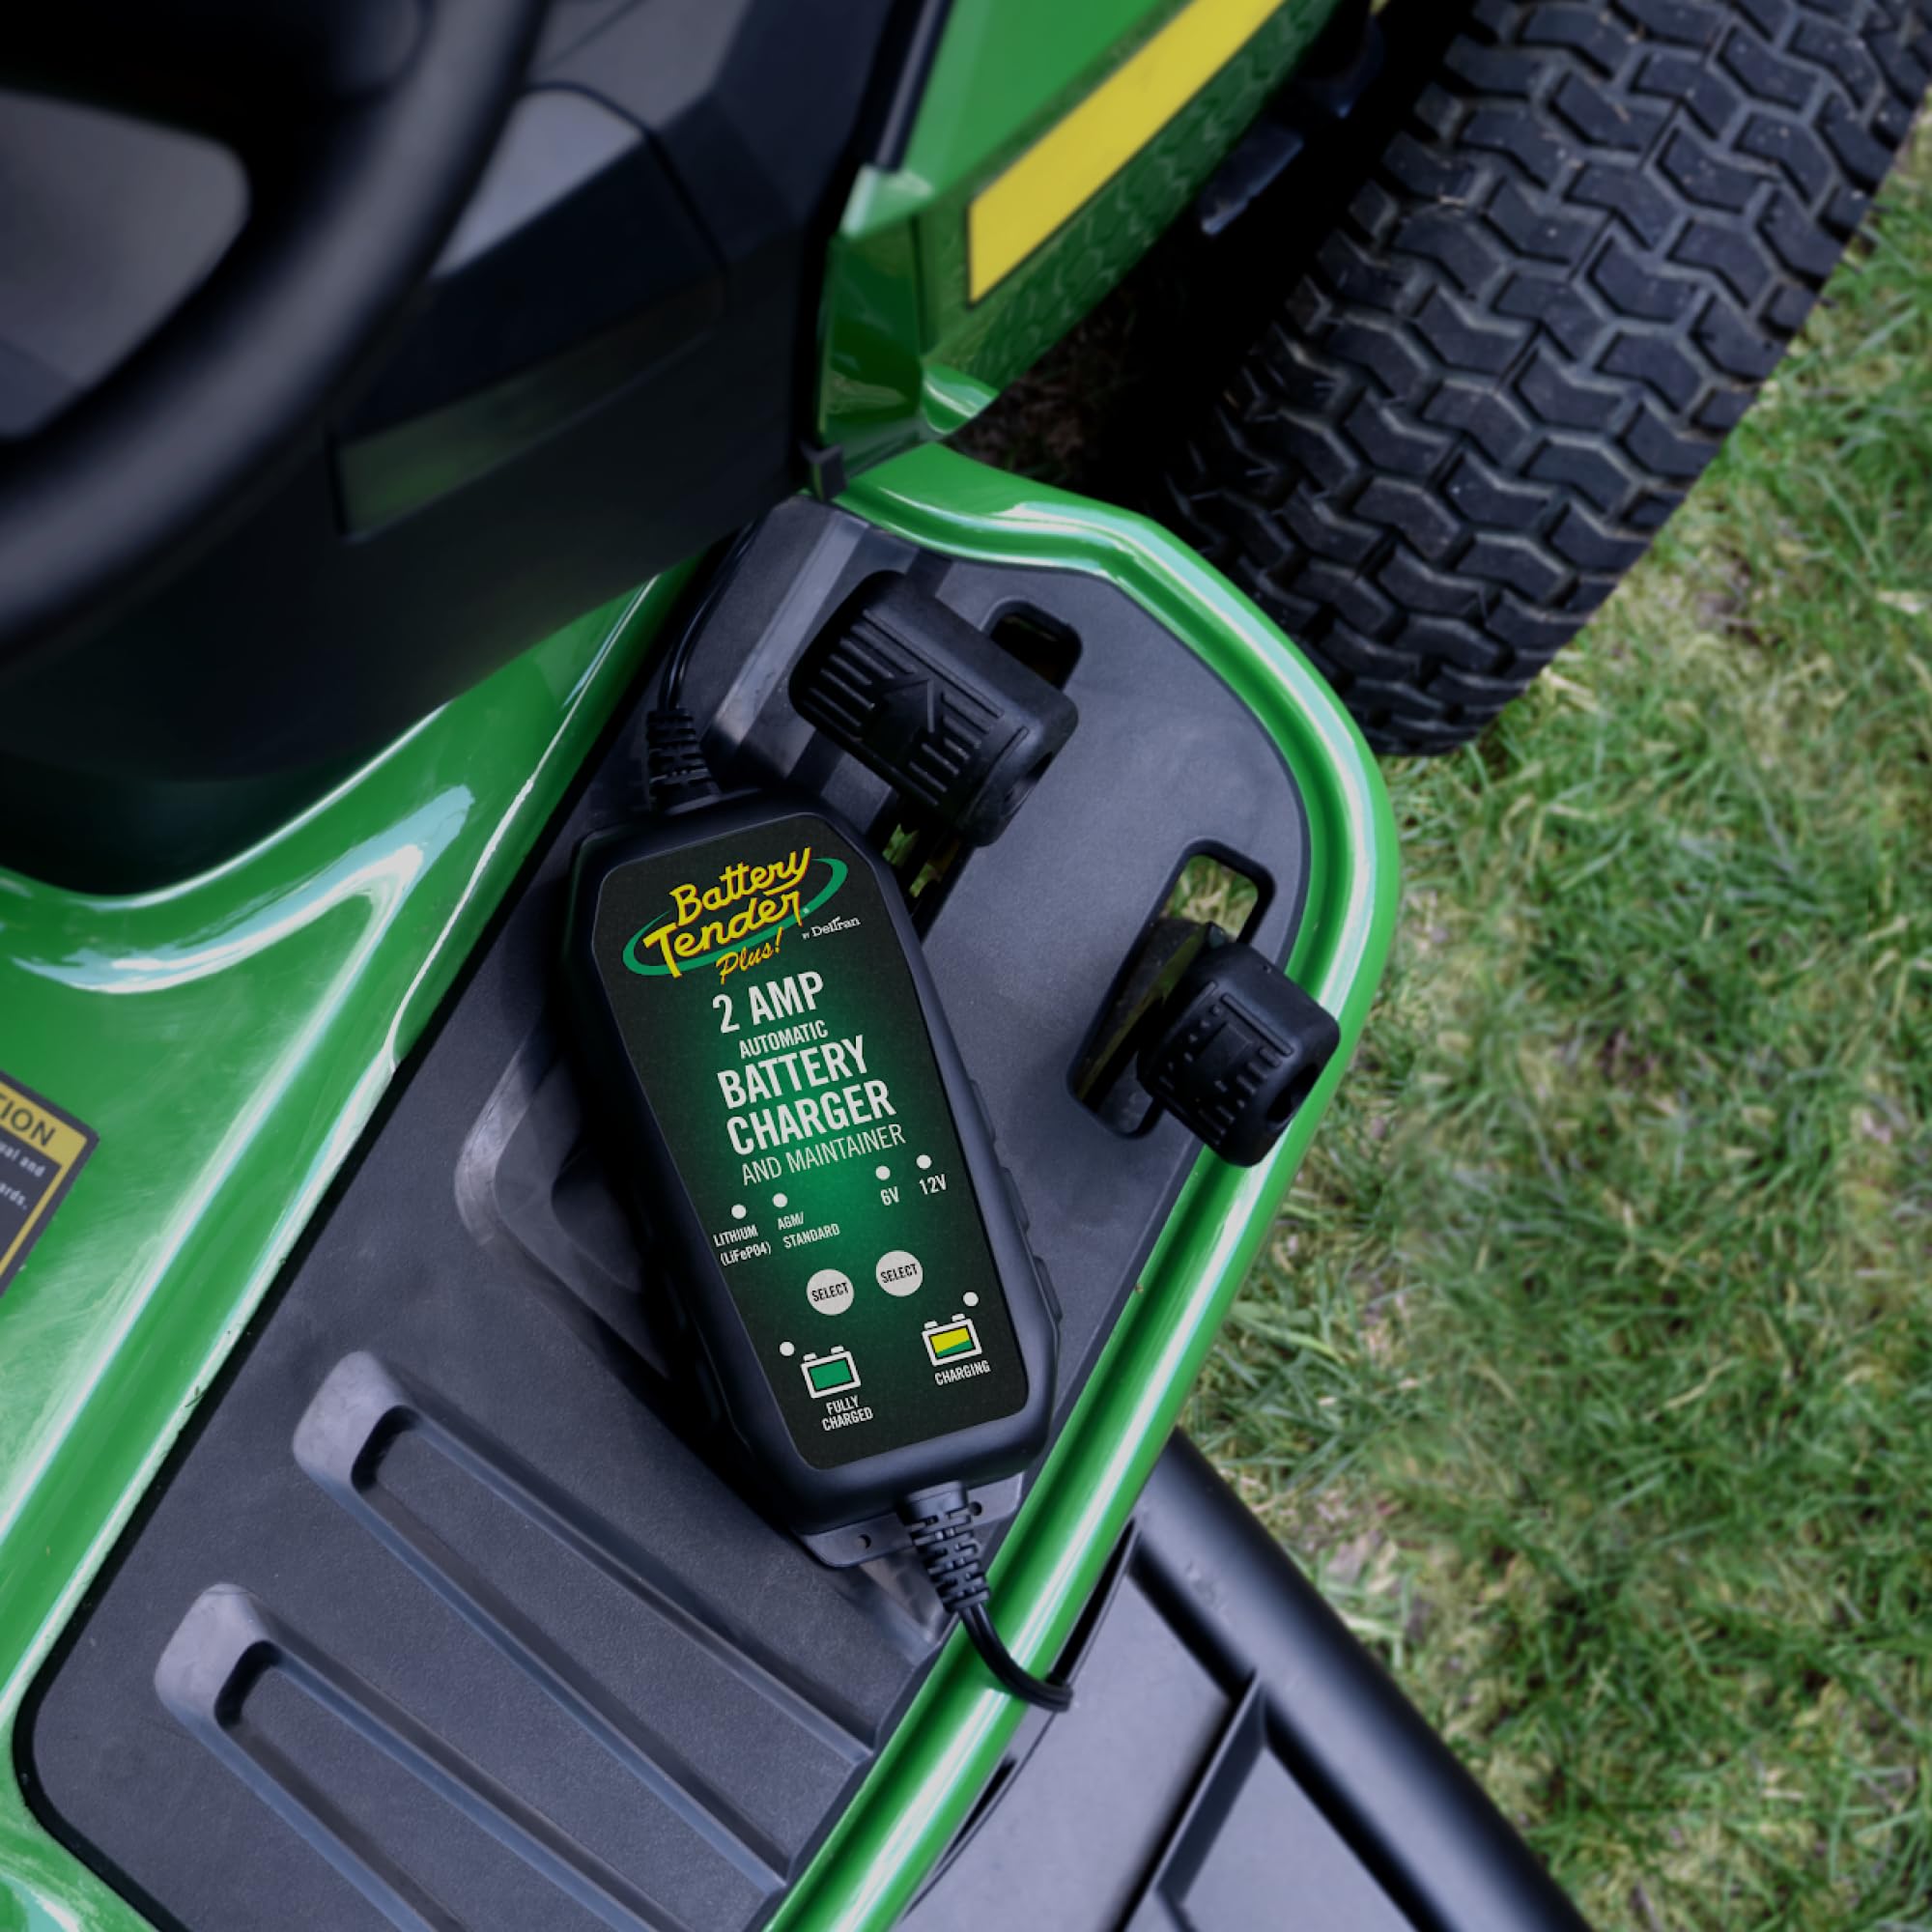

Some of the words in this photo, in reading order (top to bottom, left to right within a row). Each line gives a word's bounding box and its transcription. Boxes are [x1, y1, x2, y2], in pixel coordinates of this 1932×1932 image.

[668, 845, 811, 926] Battery
[642, 891, 804, 979] Tender
[716, 926, 783, 985] Plus!
[712, 994, 740, 1034] 2
[748, 971, 824, 1026] AMP
[738, 1019, 829, 1060] AUTOMATIC
[717, 1034, 867, 1110] BATTERY
[726, 1079, 896, 1155] CHARGER
[19, 1156, 45, 1178] and
[741, 1156, 782, 1186] AND
[785, 1123, 906, 1174] MAINTAINER
[880, 1186, 900, 1207] 6V
[919, 1174, 948, 1196] 12V
[777, 1211, 805, 1231] AGM/
[713, 1224, 759, 1248] LITHIUM
[782, 1223, 840, 1249] STANDARD
[880, 1264, 919, 1284] SELECT
[811, 1282, 850, 1302] SELECT
[934, 1359, 992, 1386] CHARGING
[826, 1395, 860, 1416] FULLY
[821, 1406, 874, 1433] CHARGED
